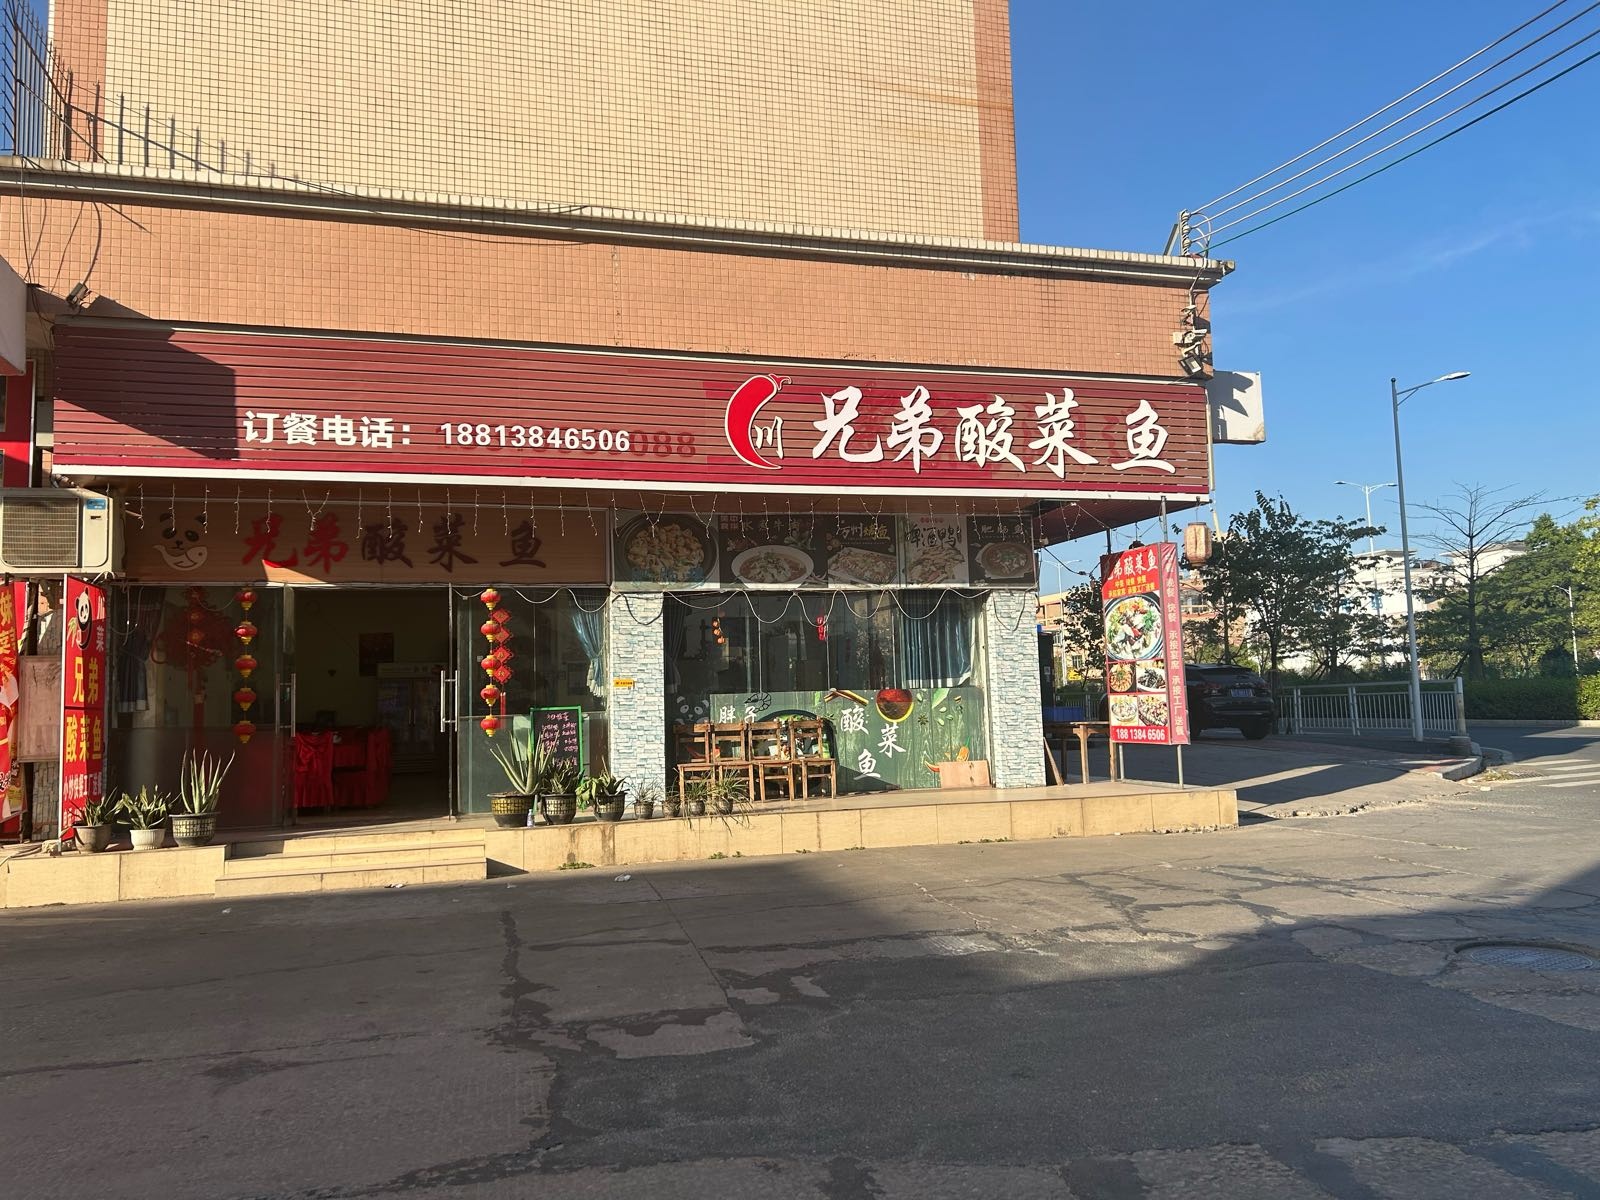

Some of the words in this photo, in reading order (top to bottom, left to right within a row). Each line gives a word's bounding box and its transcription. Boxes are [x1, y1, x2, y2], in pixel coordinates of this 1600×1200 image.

[440, 422, 630, 452] 18813846506
[754, 416, 783, 459] 川
[812, 385, 1177, 479] 兄弟酸菜鱼
[73, 657, 98, 704] 兄弟
[66, 716, 102, 763] 酸菜鱼
